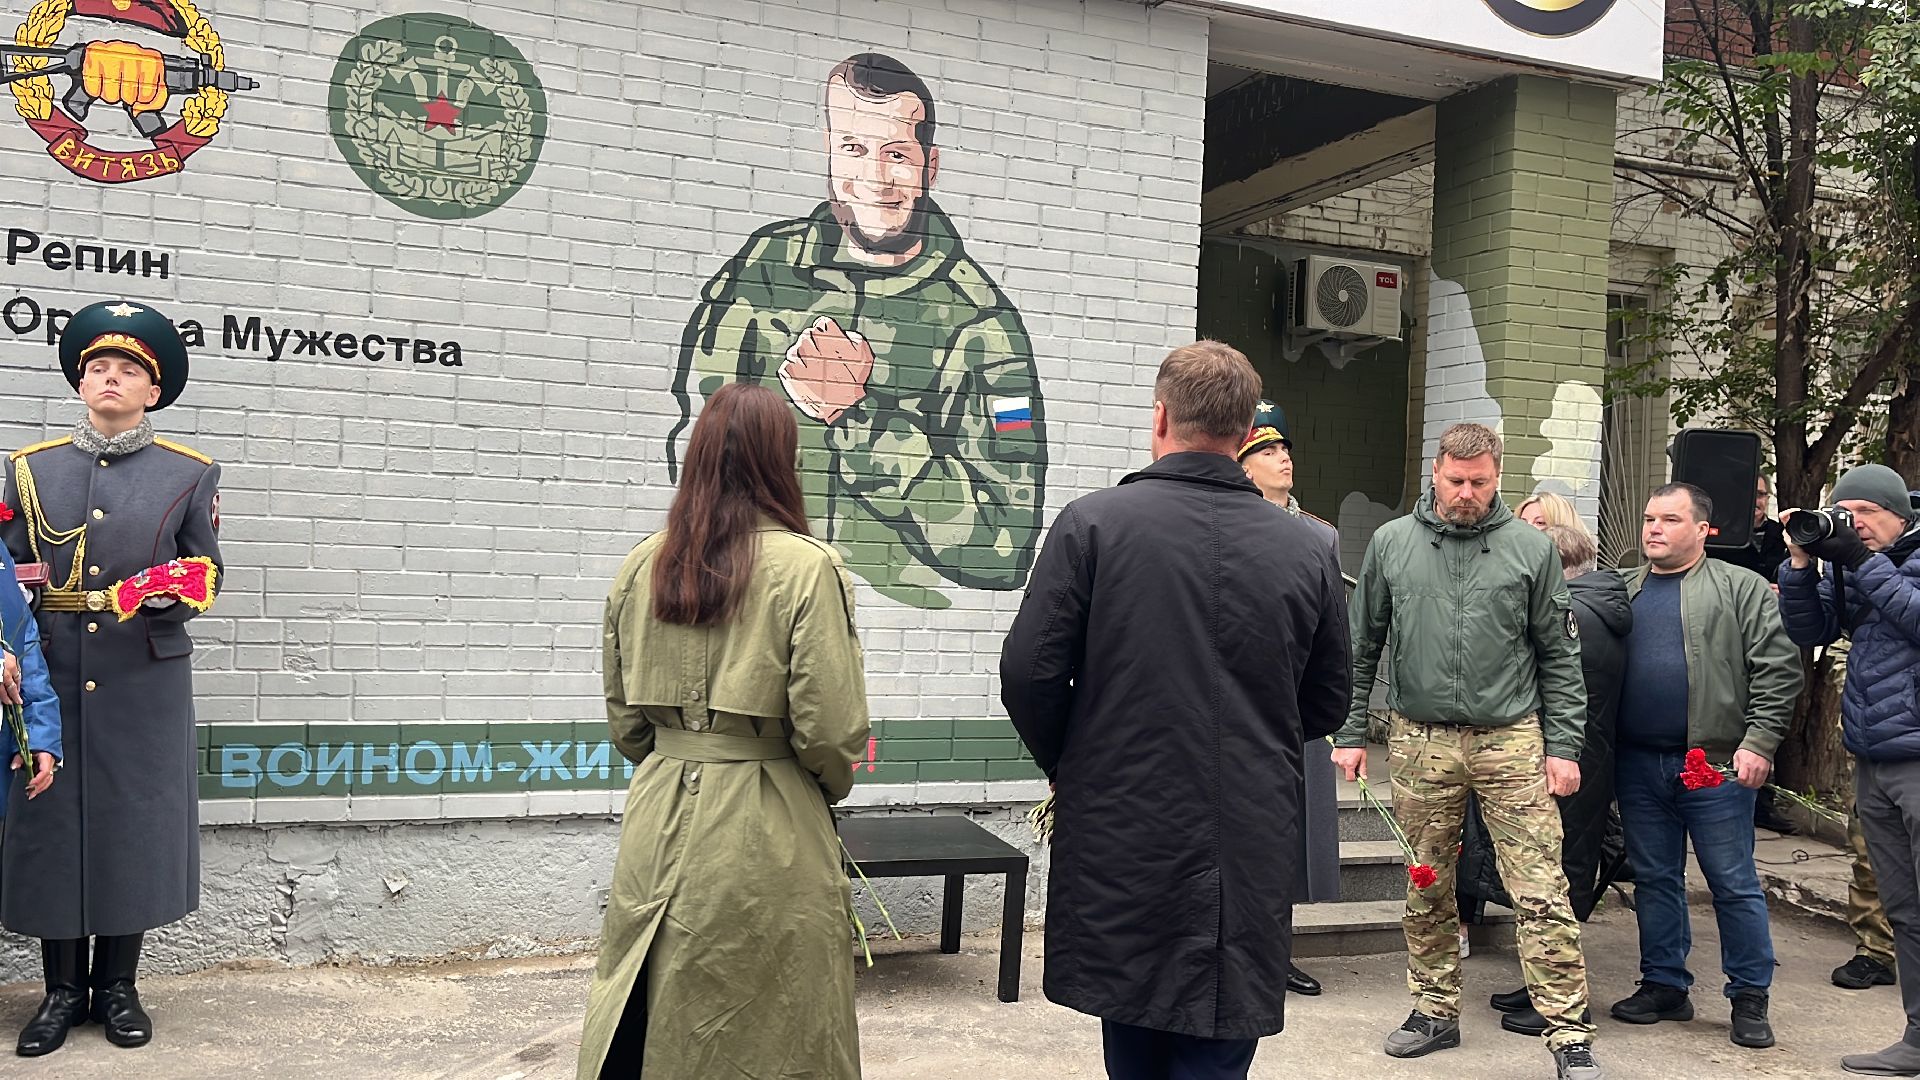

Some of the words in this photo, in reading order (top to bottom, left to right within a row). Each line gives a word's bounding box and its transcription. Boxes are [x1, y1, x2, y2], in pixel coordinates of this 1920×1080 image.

[53, 138, 180, 180] ВИТЯЗЬ
[6, 228, 170, 279] Репин
[1378, 276, 1395, 285] TCL
[3, 296, 206, 348] Ора
[222, 314, 464, 367] Мужества
